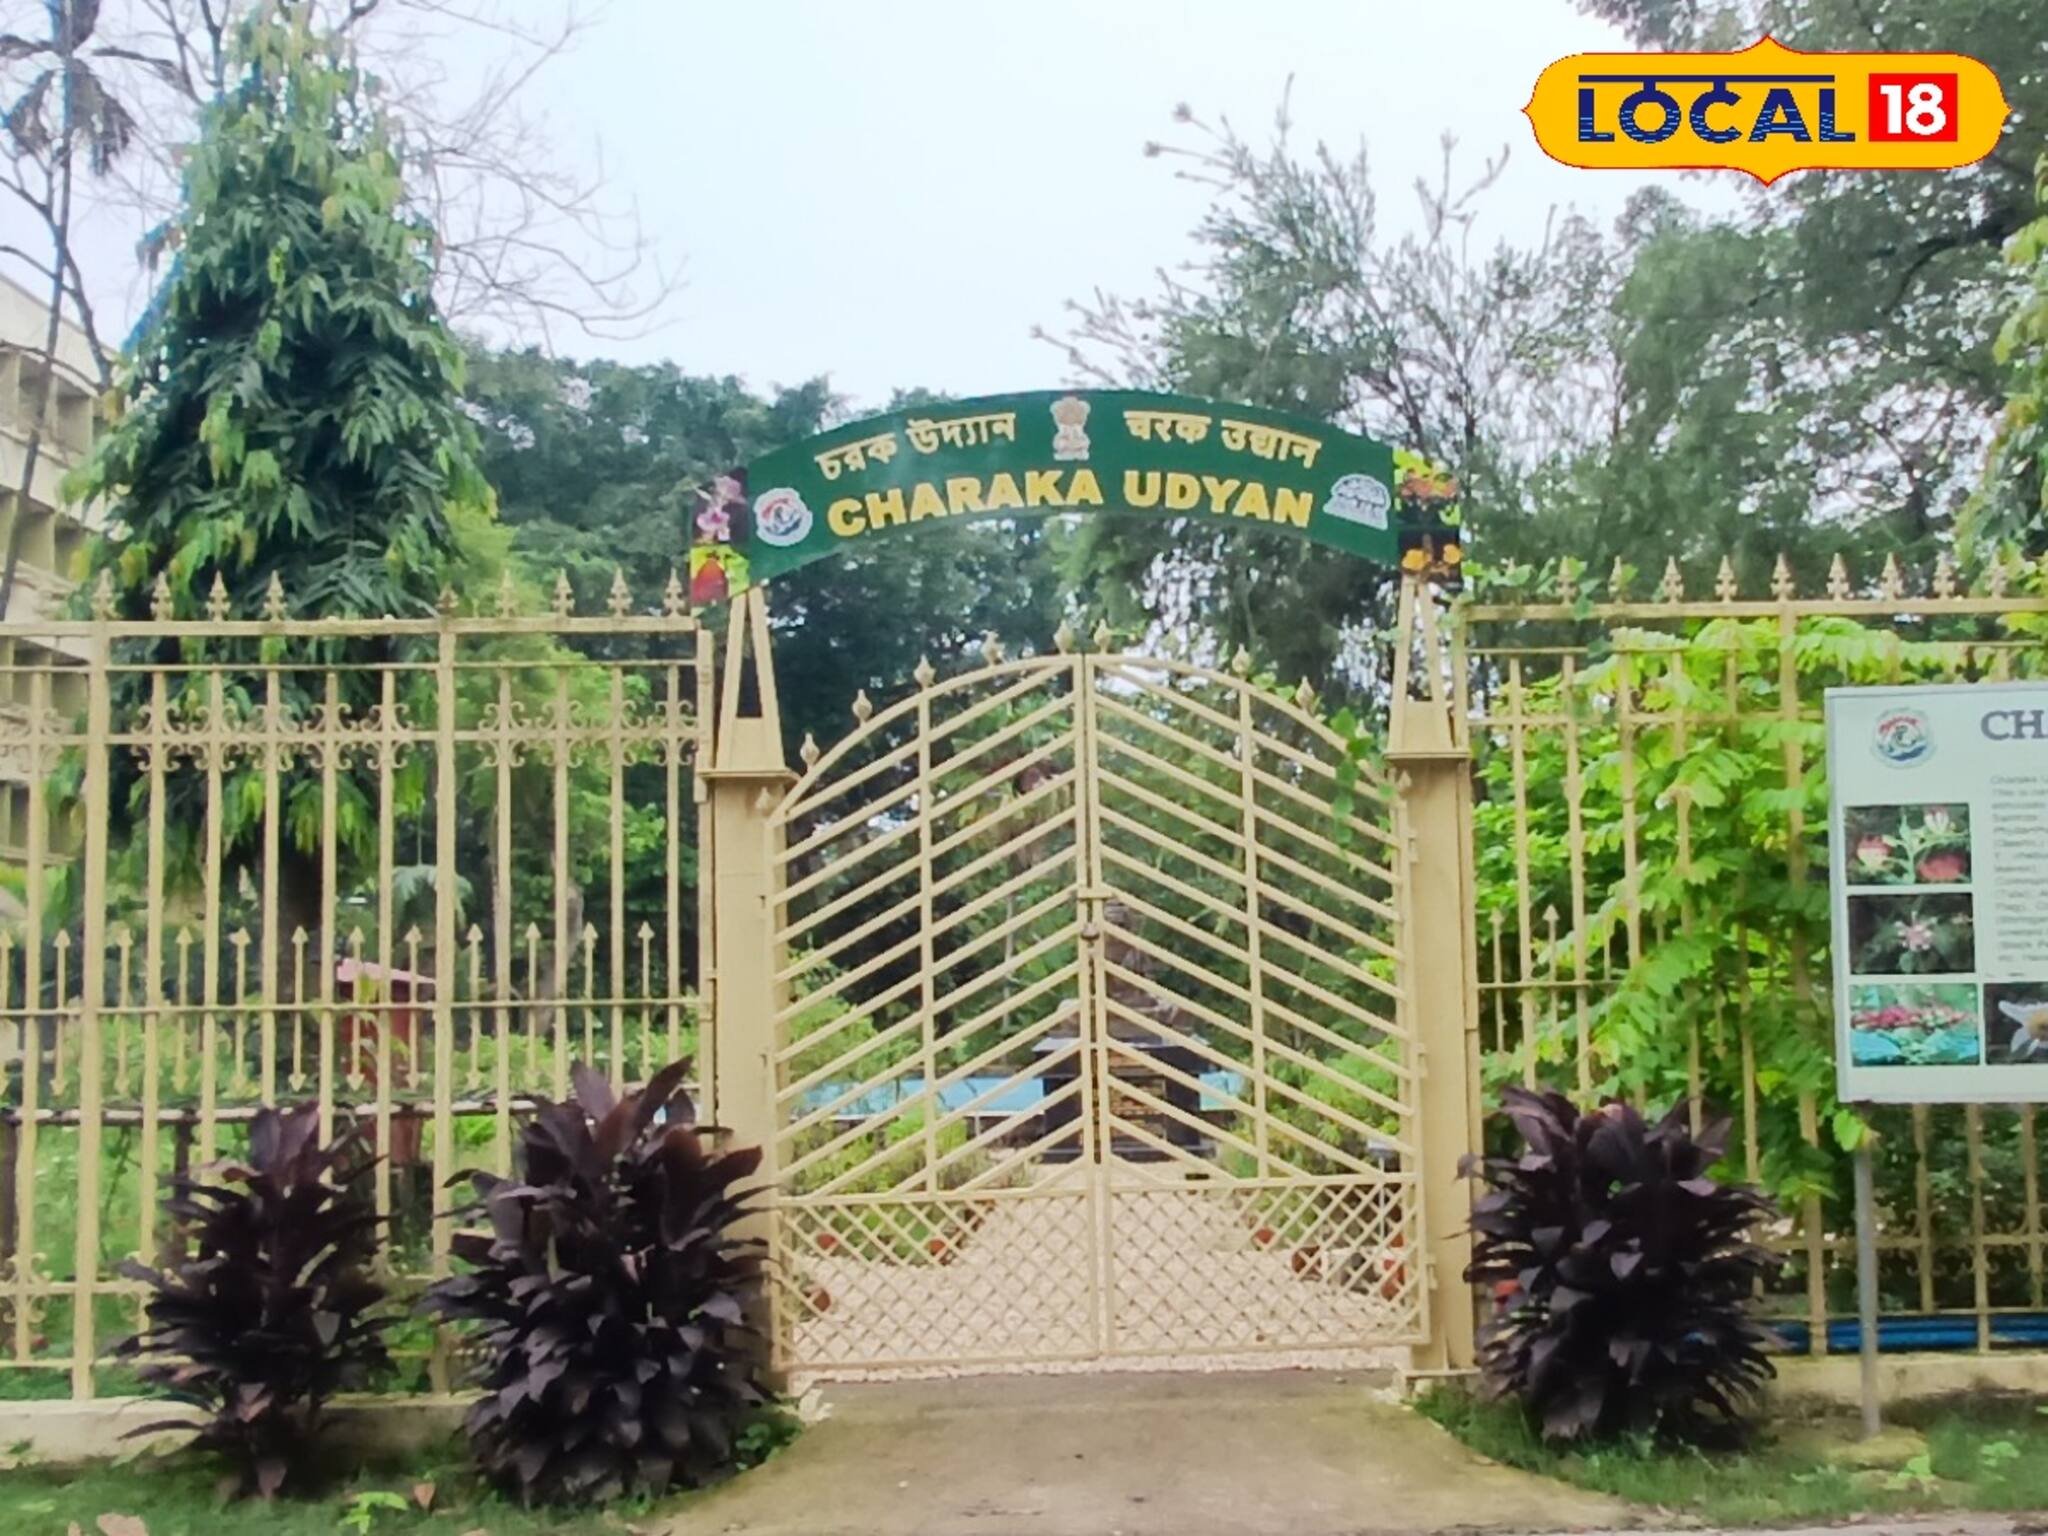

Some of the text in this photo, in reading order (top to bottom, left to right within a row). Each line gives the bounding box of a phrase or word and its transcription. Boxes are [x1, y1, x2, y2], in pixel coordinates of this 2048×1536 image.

[813, 411, 1017, 481] চরক উদ্যান
[1123, 410, 1322, 469] चरक उद्यान
[827, 469, 1314, 537] CHARAKA UDYAN
[1980, 709, 2048, 741] CH
